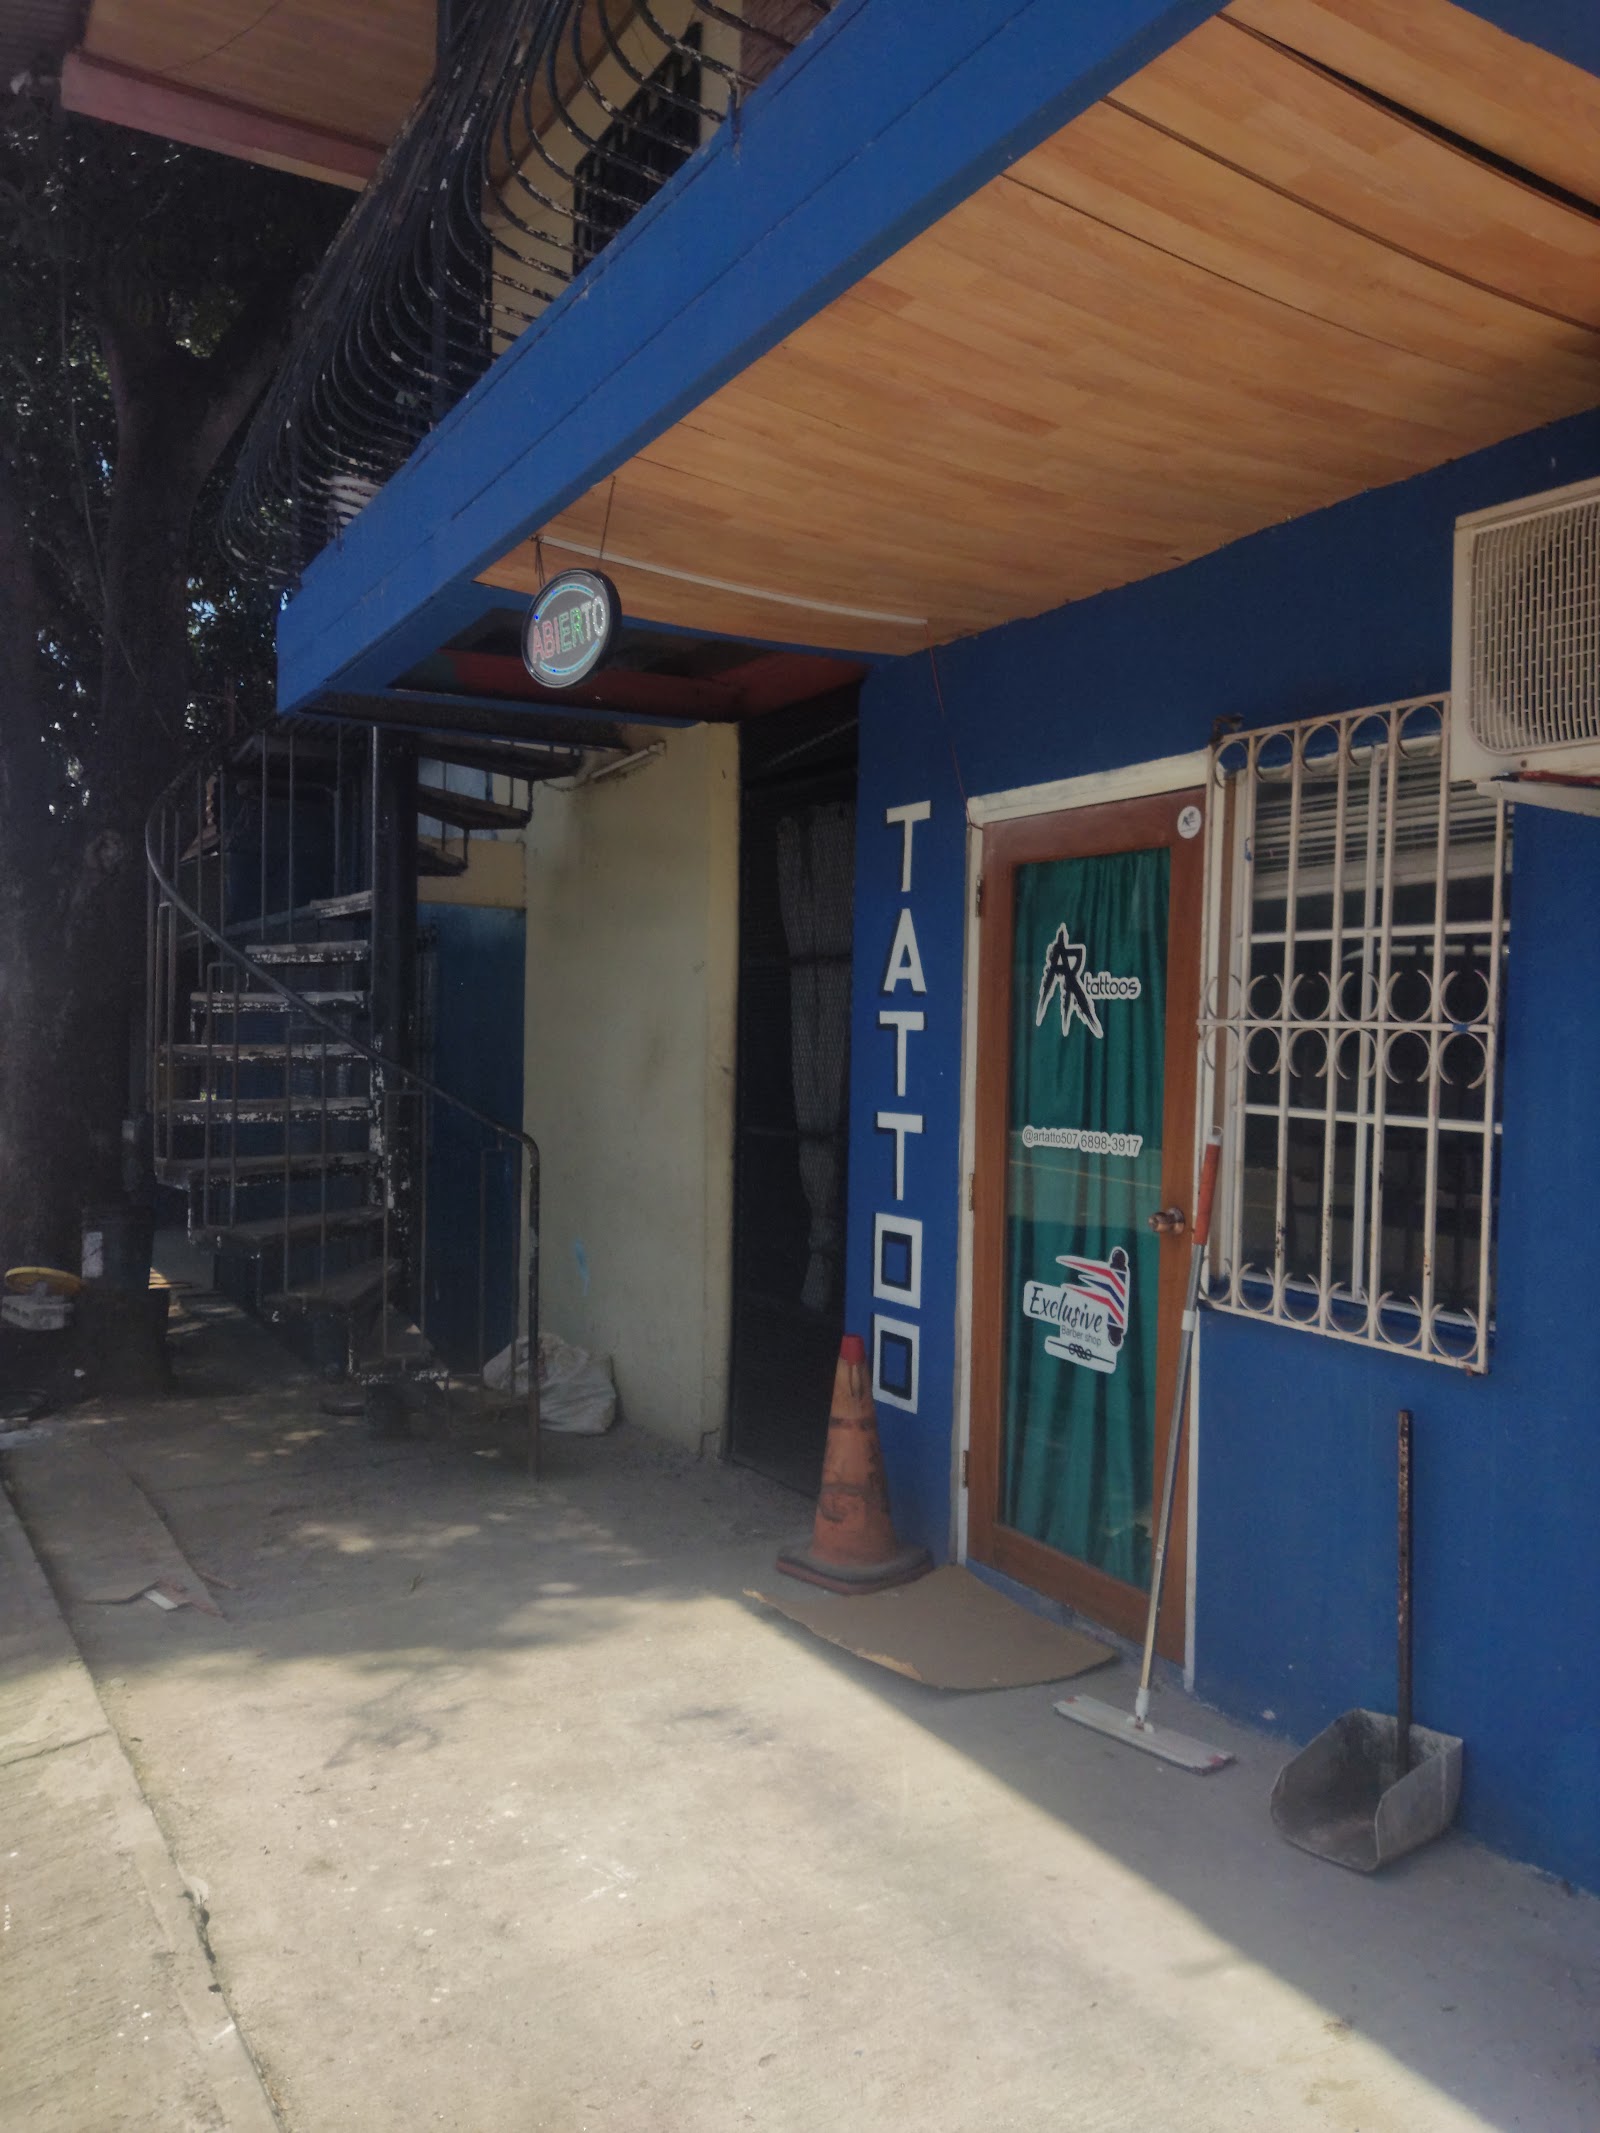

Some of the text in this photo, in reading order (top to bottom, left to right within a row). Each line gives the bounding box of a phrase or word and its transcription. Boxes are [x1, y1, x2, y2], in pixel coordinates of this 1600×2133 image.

[532, 596, 606, 664] ABIERTO
[1085, 975, 1138, 996] tattoos
[872, 800, 931, 1414] TATTOO
[1023, 1128, 1140, 1153] @artatto507 6898-3917
[1029, 1286, 1103, 1333] Exclusive
[1061, 1325, 1102, 1347] Barber shop
